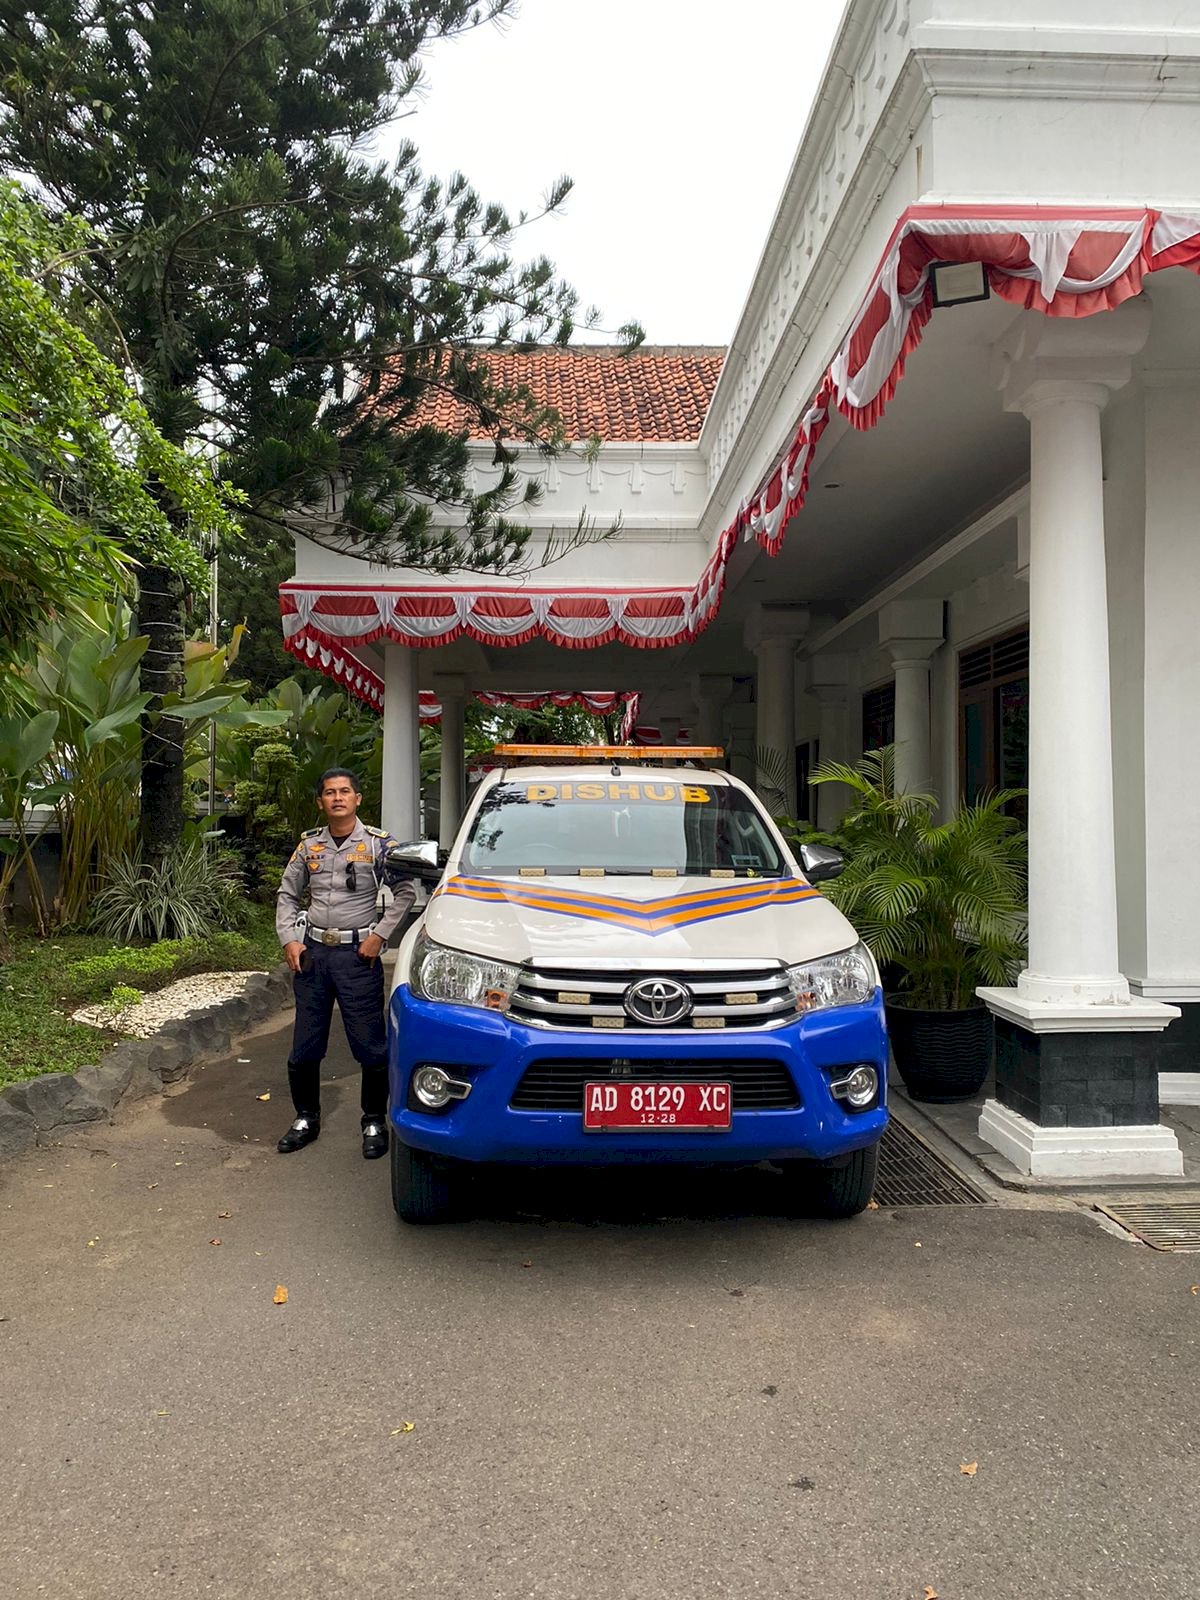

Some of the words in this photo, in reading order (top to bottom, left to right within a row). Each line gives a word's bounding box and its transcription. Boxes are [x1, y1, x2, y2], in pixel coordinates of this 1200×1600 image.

[526, 783, 711, 803] DISHUB
[590, 1087, 618, 1112] AD
[630, 1086, 685, 1112] 8129
[698, 1086, 726, 1112] XC
